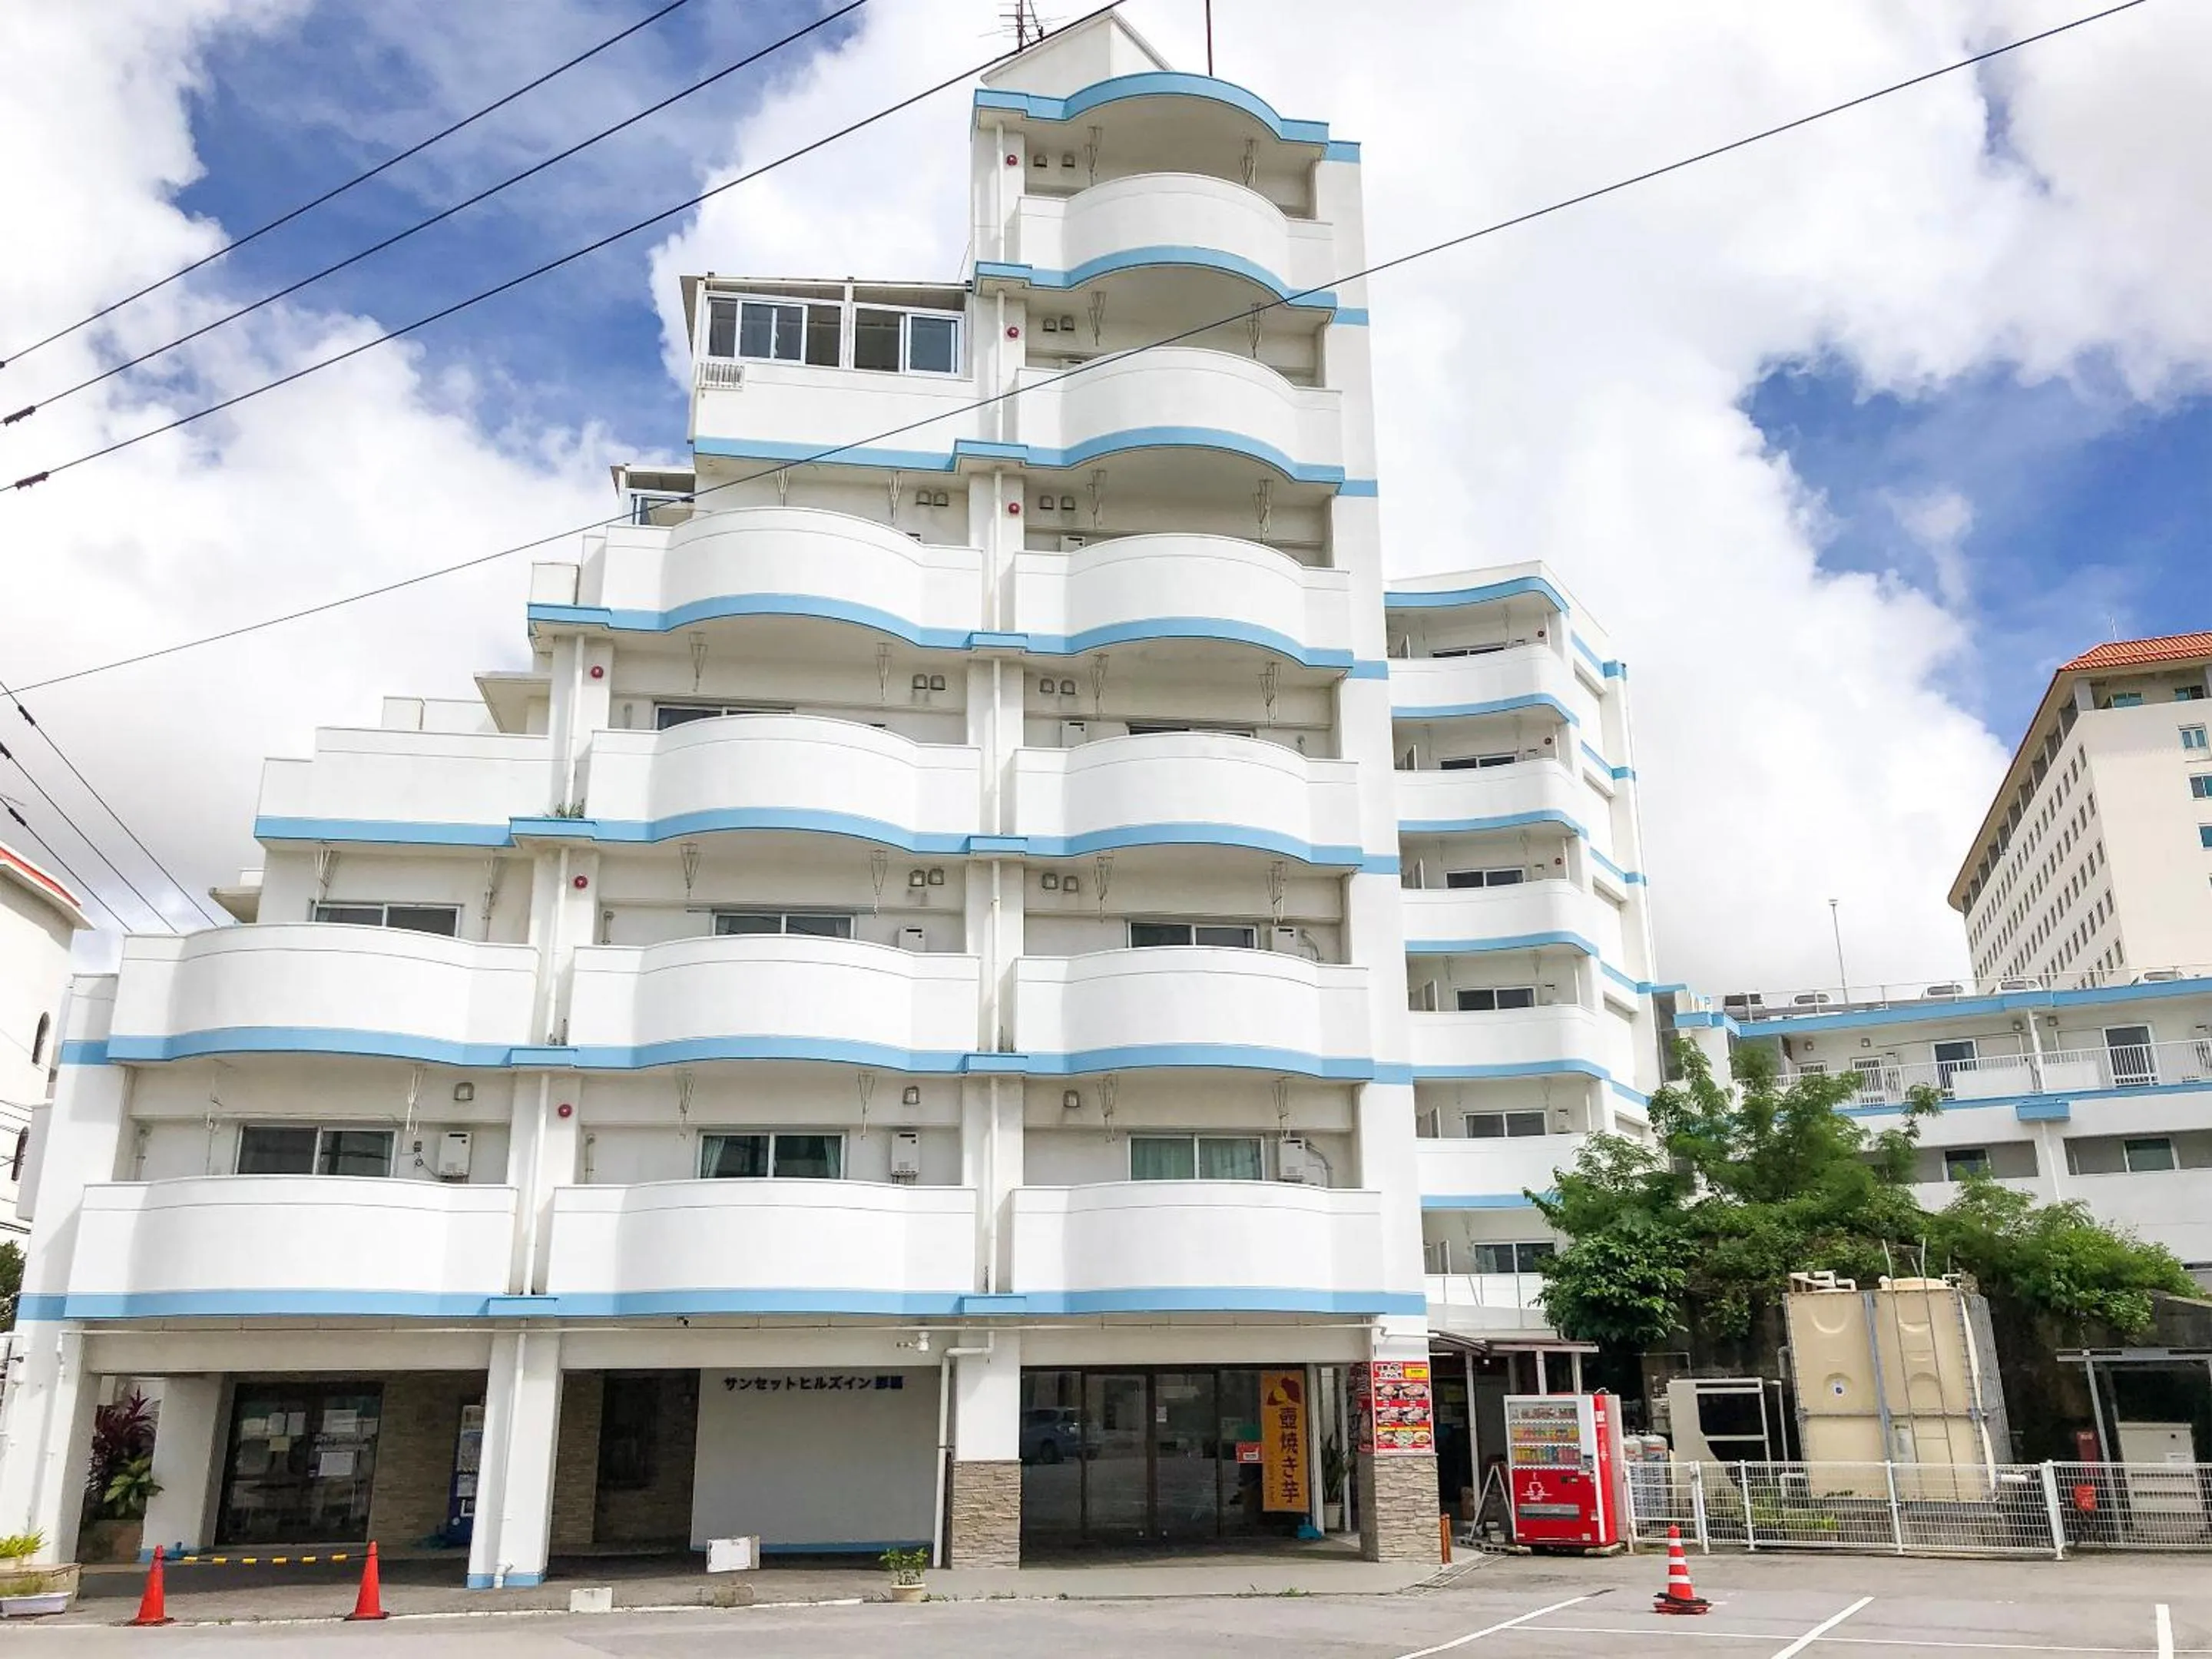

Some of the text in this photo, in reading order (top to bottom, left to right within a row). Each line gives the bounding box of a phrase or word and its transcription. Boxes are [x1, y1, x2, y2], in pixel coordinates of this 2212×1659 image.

[723, 1376, 903, 1391] サンセットヒルズイン
